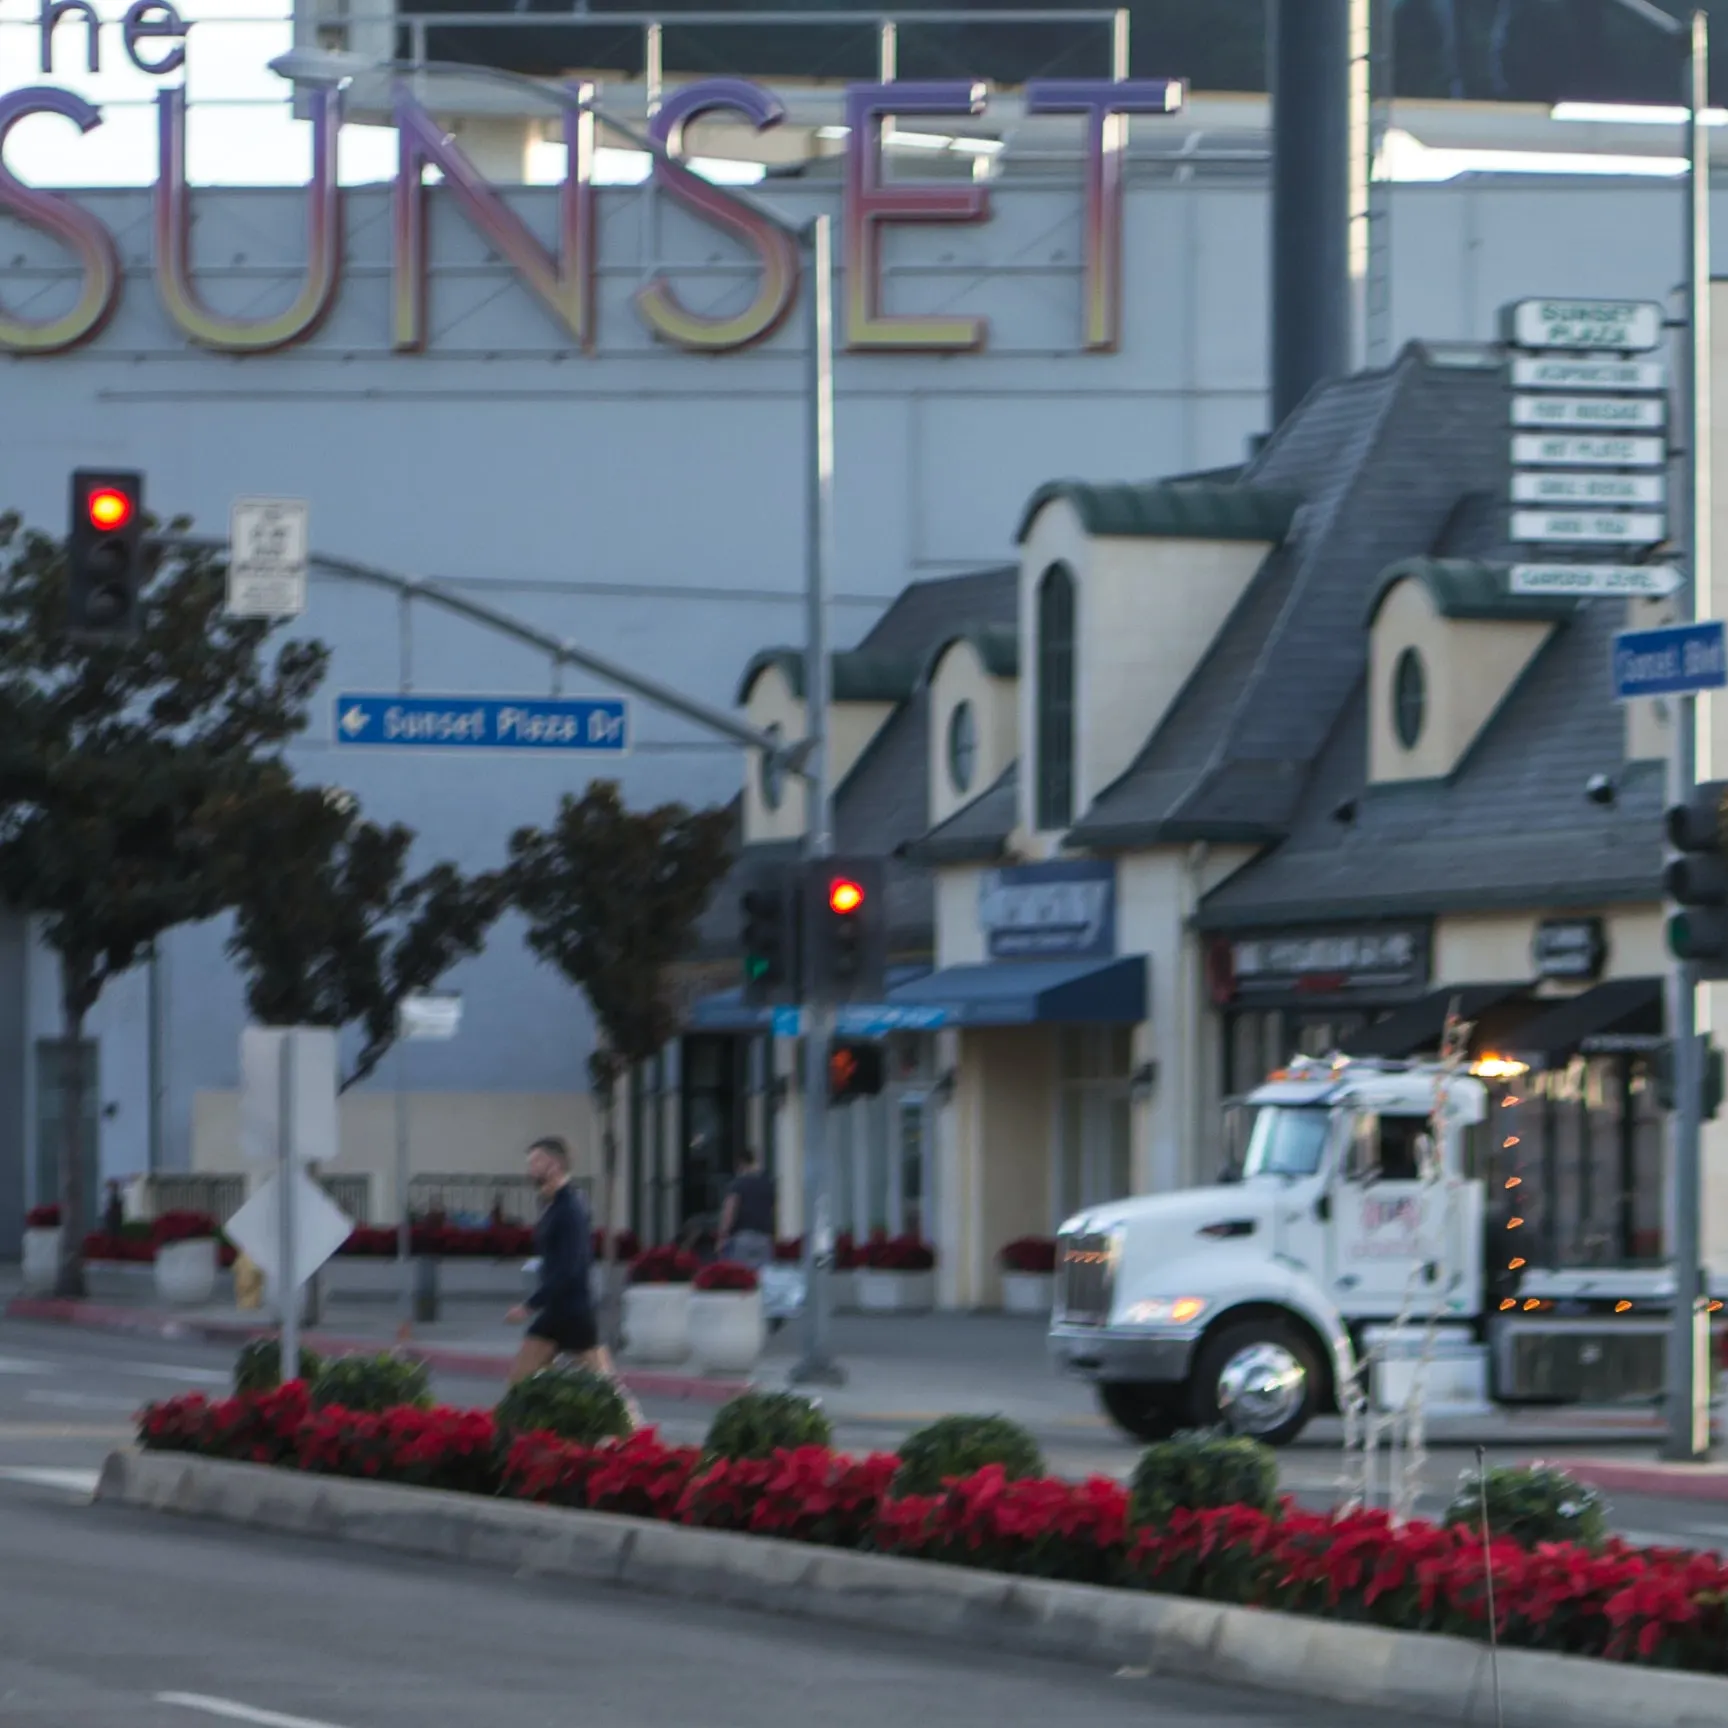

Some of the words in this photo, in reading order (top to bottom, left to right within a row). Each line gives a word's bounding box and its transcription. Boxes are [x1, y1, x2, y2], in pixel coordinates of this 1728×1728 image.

[0, 78, 1186, 355] SUNSET
[382, 705, 486, 741] Sunset
[497, 706, 578, 742] Plaza
[587, 709, 624, 744] Dr
